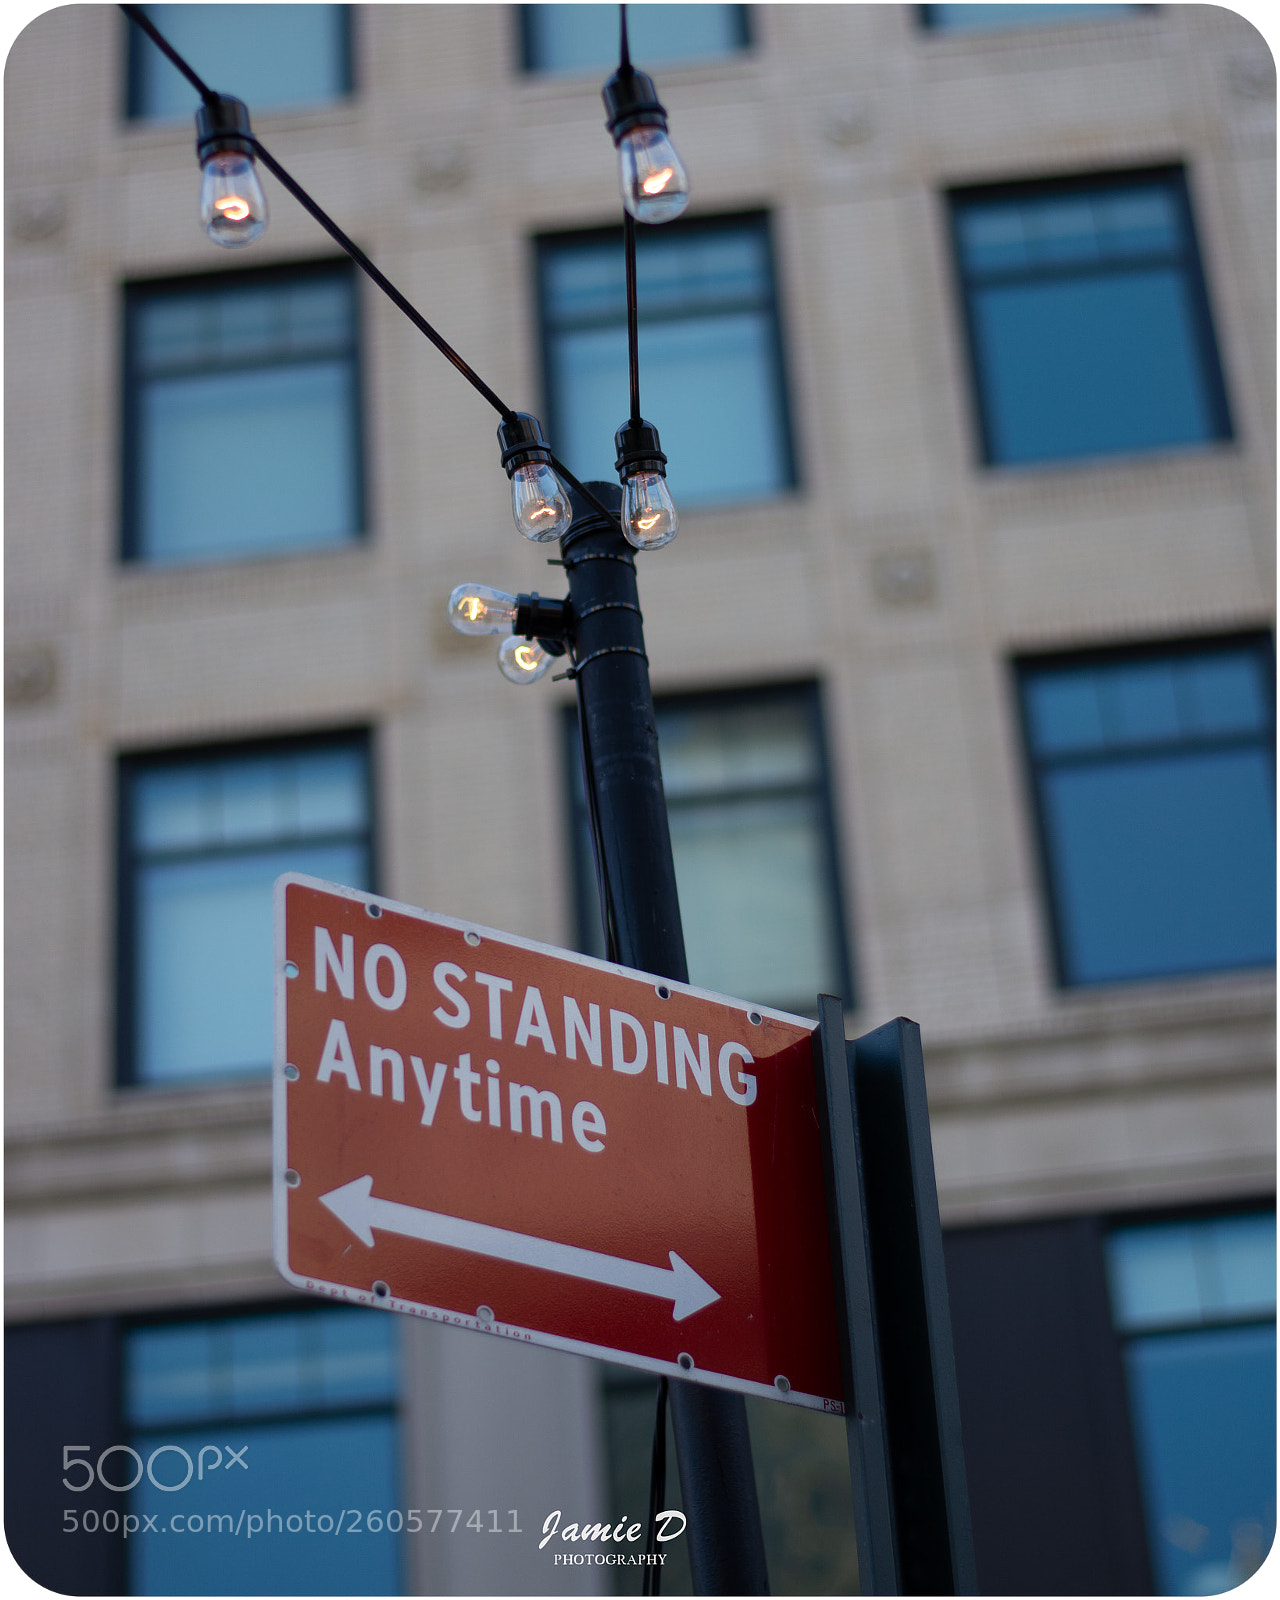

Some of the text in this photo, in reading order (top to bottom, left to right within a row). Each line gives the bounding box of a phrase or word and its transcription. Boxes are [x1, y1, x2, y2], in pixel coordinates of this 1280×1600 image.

[314, 926, 758, 1106] NO STANDING
[316, 1018, 608, 1153] Anytime
[305, 1279, 533, 1342] Dept of Transportation
